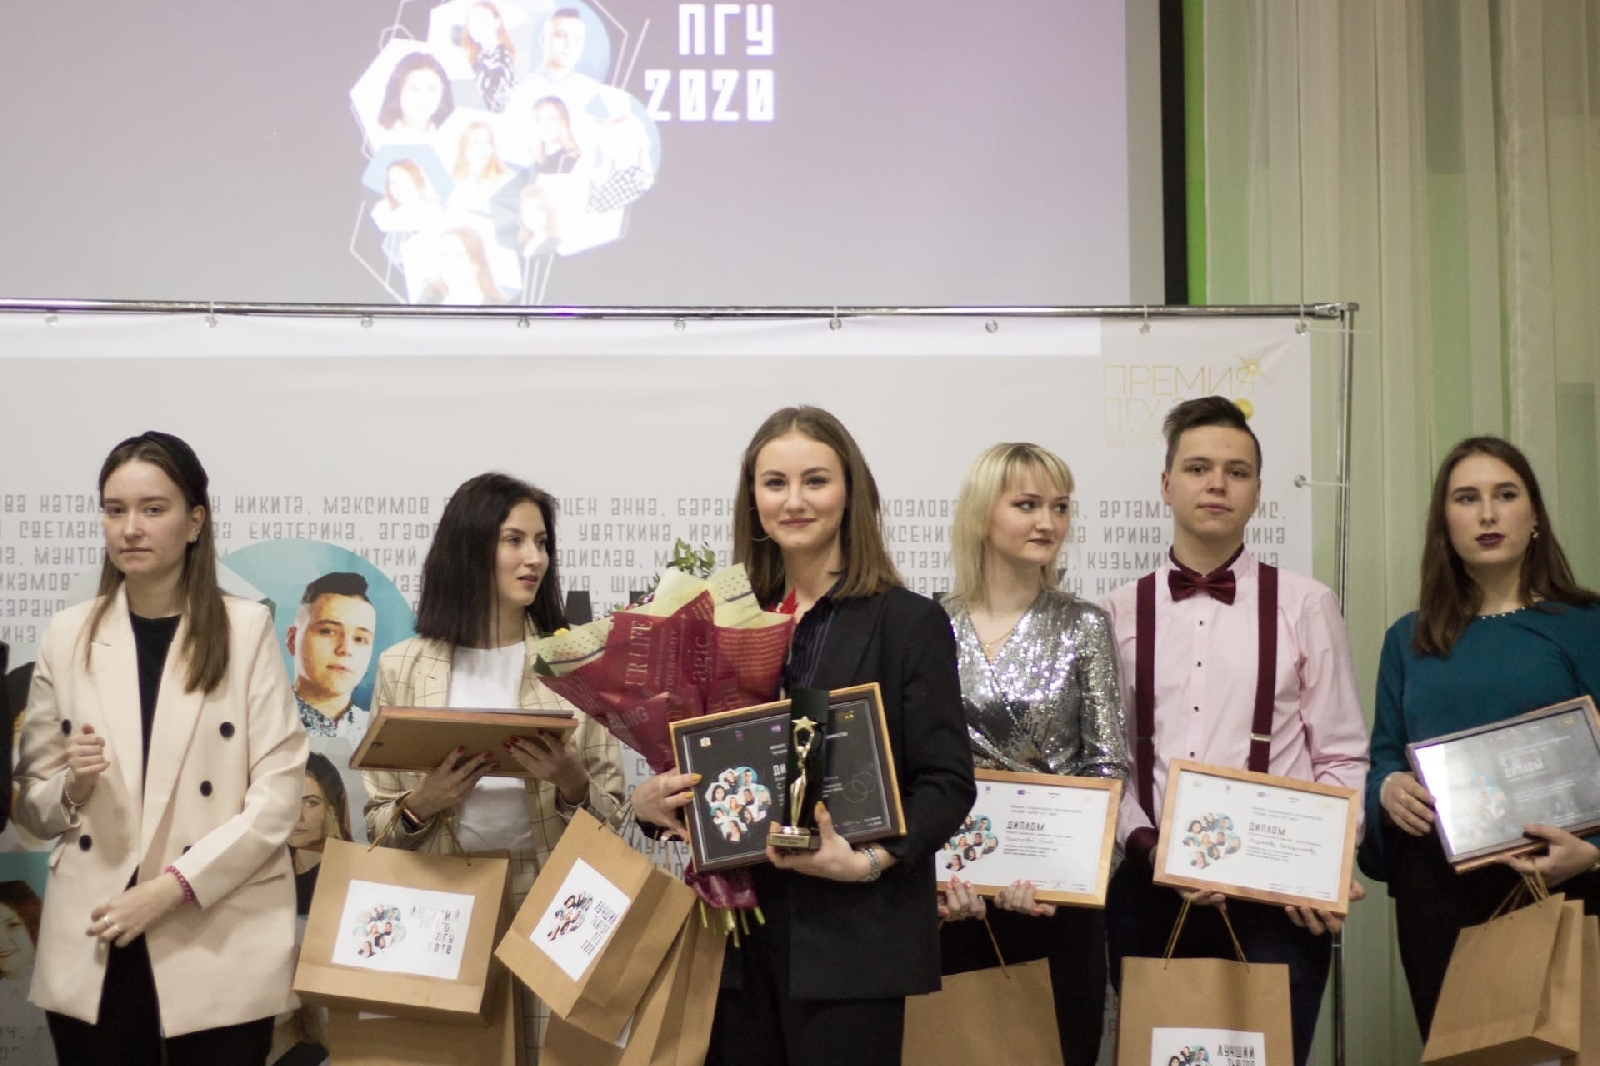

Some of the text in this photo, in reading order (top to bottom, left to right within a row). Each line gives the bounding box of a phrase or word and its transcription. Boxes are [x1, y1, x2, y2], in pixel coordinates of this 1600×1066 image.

[679, 4, 773, 55] ПГУ
[644, 69, 774, 121] 2020
[234, 496, 312, 516] НИКИТА,
[324, 496, 430, 515] МАКСИМОВ
[611, 497, 666, 518] АННА,
[249, 522, 364, 542] ЕКАТЕРИНА,
[1248, 821, 1287, 836] ДИПЛОМ
